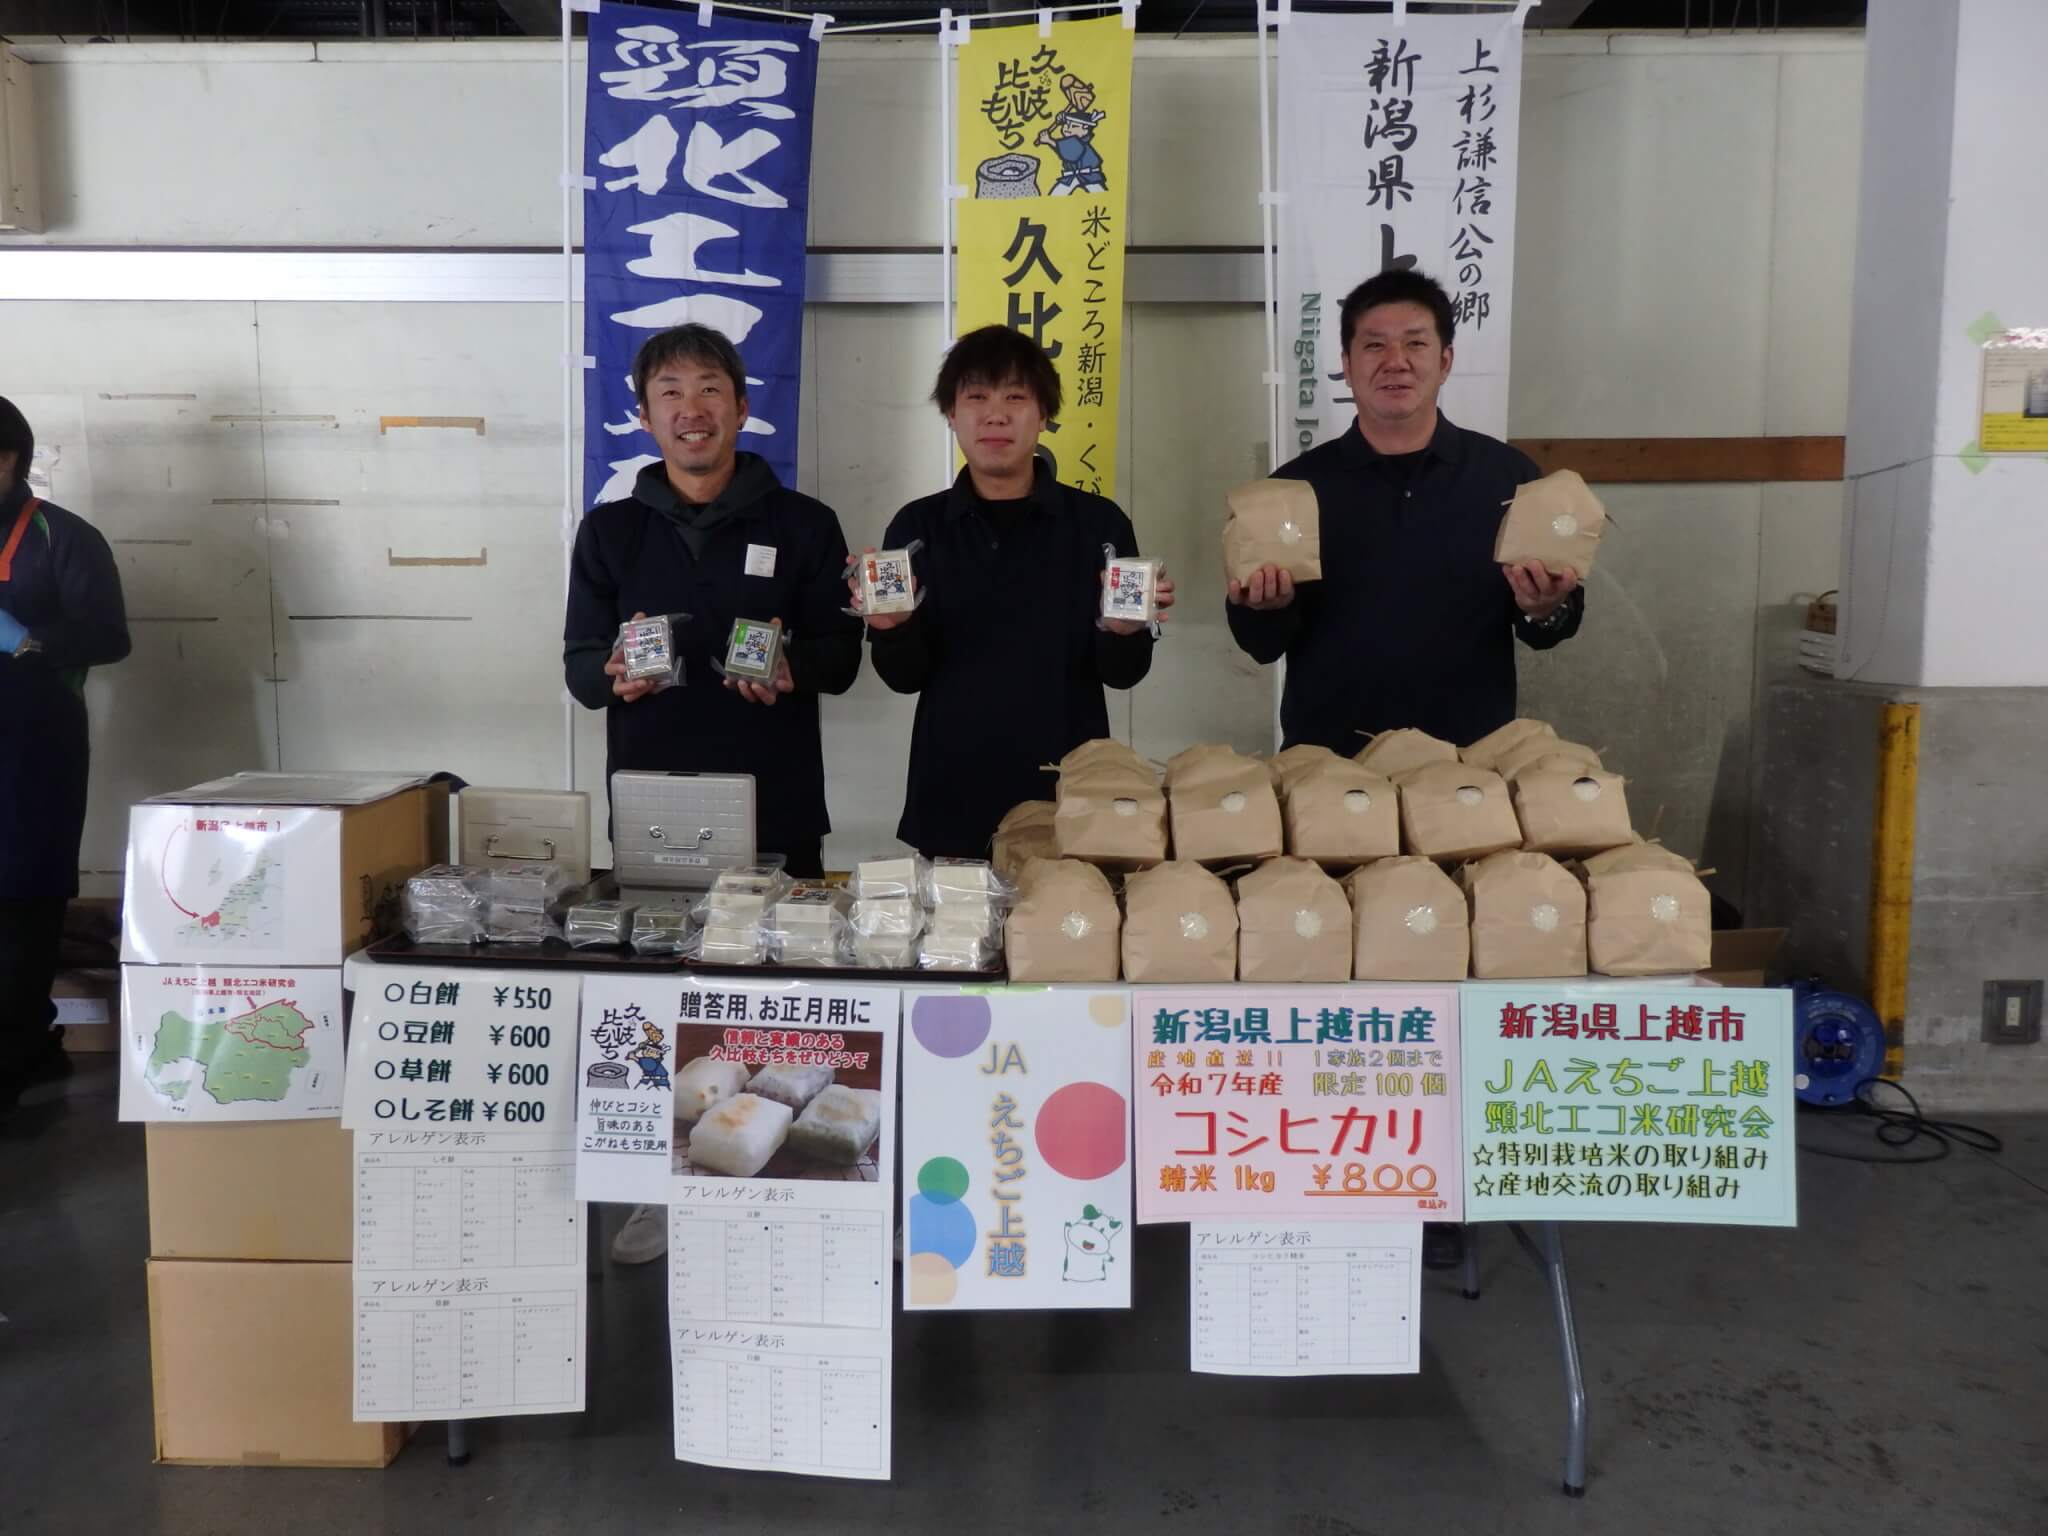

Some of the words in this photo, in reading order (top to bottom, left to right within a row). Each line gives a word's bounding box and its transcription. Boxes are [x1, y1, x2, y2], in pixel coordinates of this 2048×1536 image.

[1448, 38, 1500, 332] 上杉謙信公の郷
[1294, 291, 1321, 409] Niigata
[493, 985, 552, 1010] ¥550
[1152, 1006, 1437, 1045] 新潟県上越市産
[1499, 1001, 1746, 1042] 新潟県上越市
[489, 1024, 551, 1048] ¥600
[709, 1046, 869, 1069] 久比岐もちをぜひどうぞ
[980, 1043, 1028, 1075] JA
[487, 1063, 549, 1086] ¥600
[1151, 1072, 1284, 1096] 令和7年産
[1484, 1057, 1771, 1098] JAえちご上越
[482, 1100, 546, 1123] ¥600
[1484, 1101, 1775, 1139] 頸北エコ米研究会
[369, 1131, 487, 1146] アレルゲン表示
[1174, 1106, 1423, 1157] コシヒカリ
[988, 1093, 1027, 1278] えちご上越
[1159, 1163, 1218, 1193] 精米
[1234, 1164, 1275, 1193] 1kg
[1312, 1162, 1438, 1192] ¥800
[684, 1185, 795, 1201] アレルゲン表示
[1198, 1231, 1312, 1245] アレルゲン表示
[373, 1277, 489, 1293] アレルゲン表示
[677, 1328, 785, 1348] アレルゲン表示
